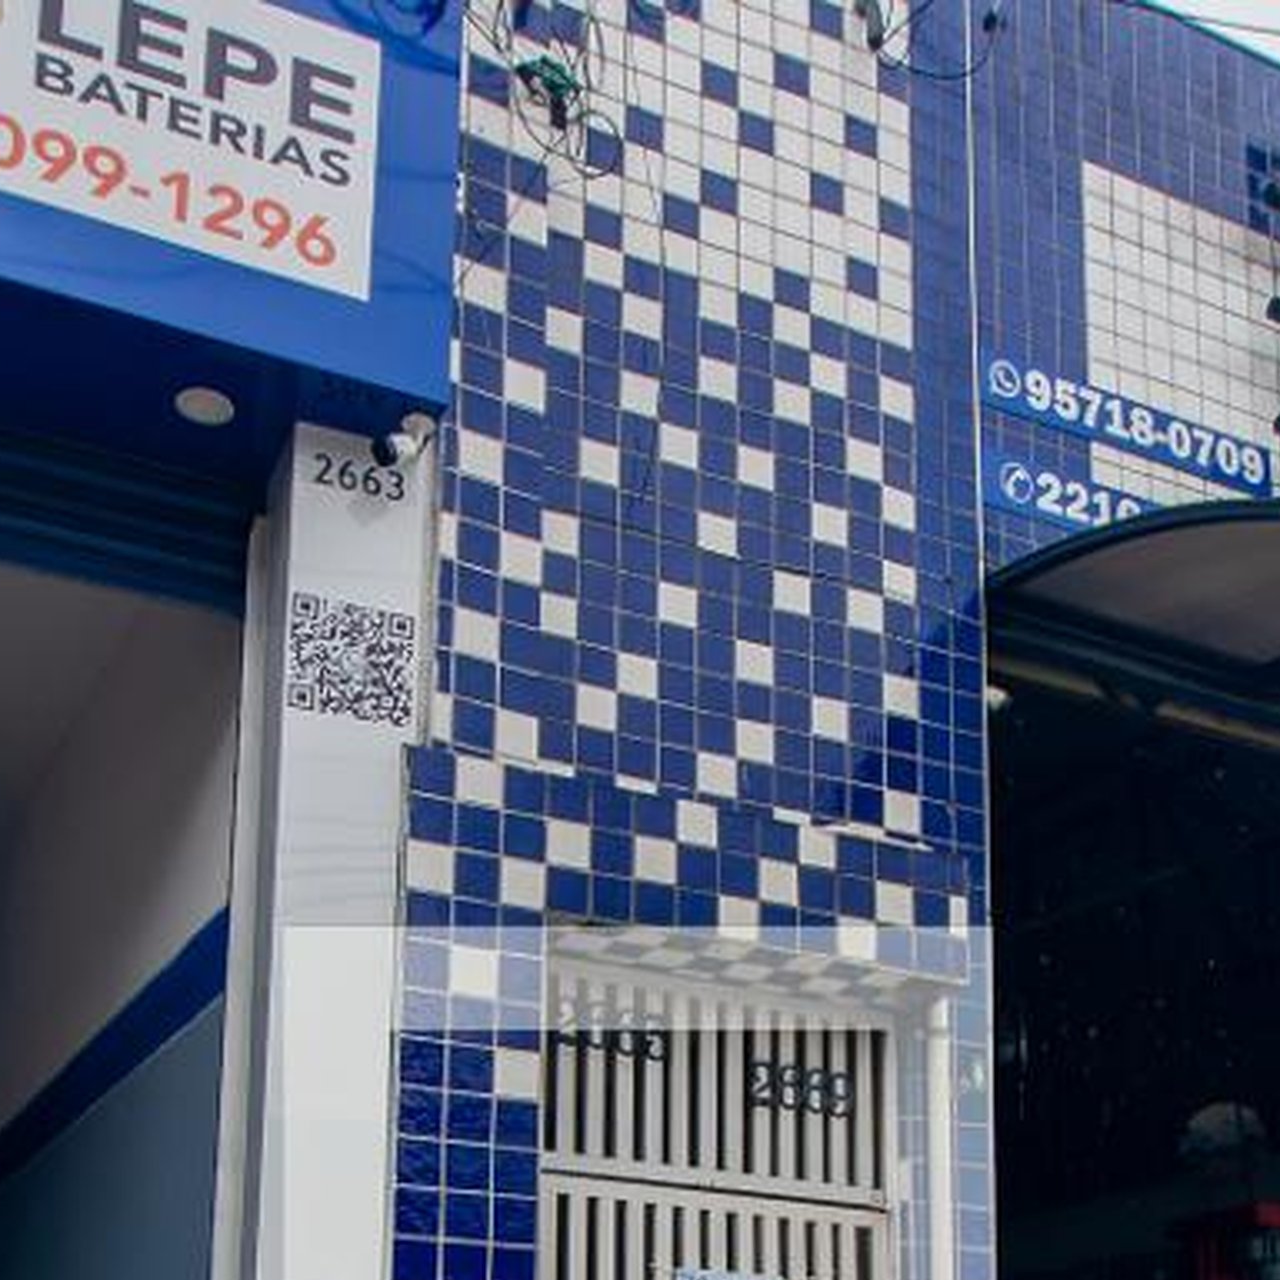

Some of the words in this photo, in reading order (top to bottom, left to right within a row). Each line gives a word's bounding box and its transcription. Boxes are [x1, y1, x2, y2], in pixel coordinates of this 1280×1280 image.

[34, 50, 352, 188] BATERIAS
[37, 0, 357, 146] LEPE
[314, 452, 406, 501] 2663
[1024, 369, 1266, 485] 95718-0709
